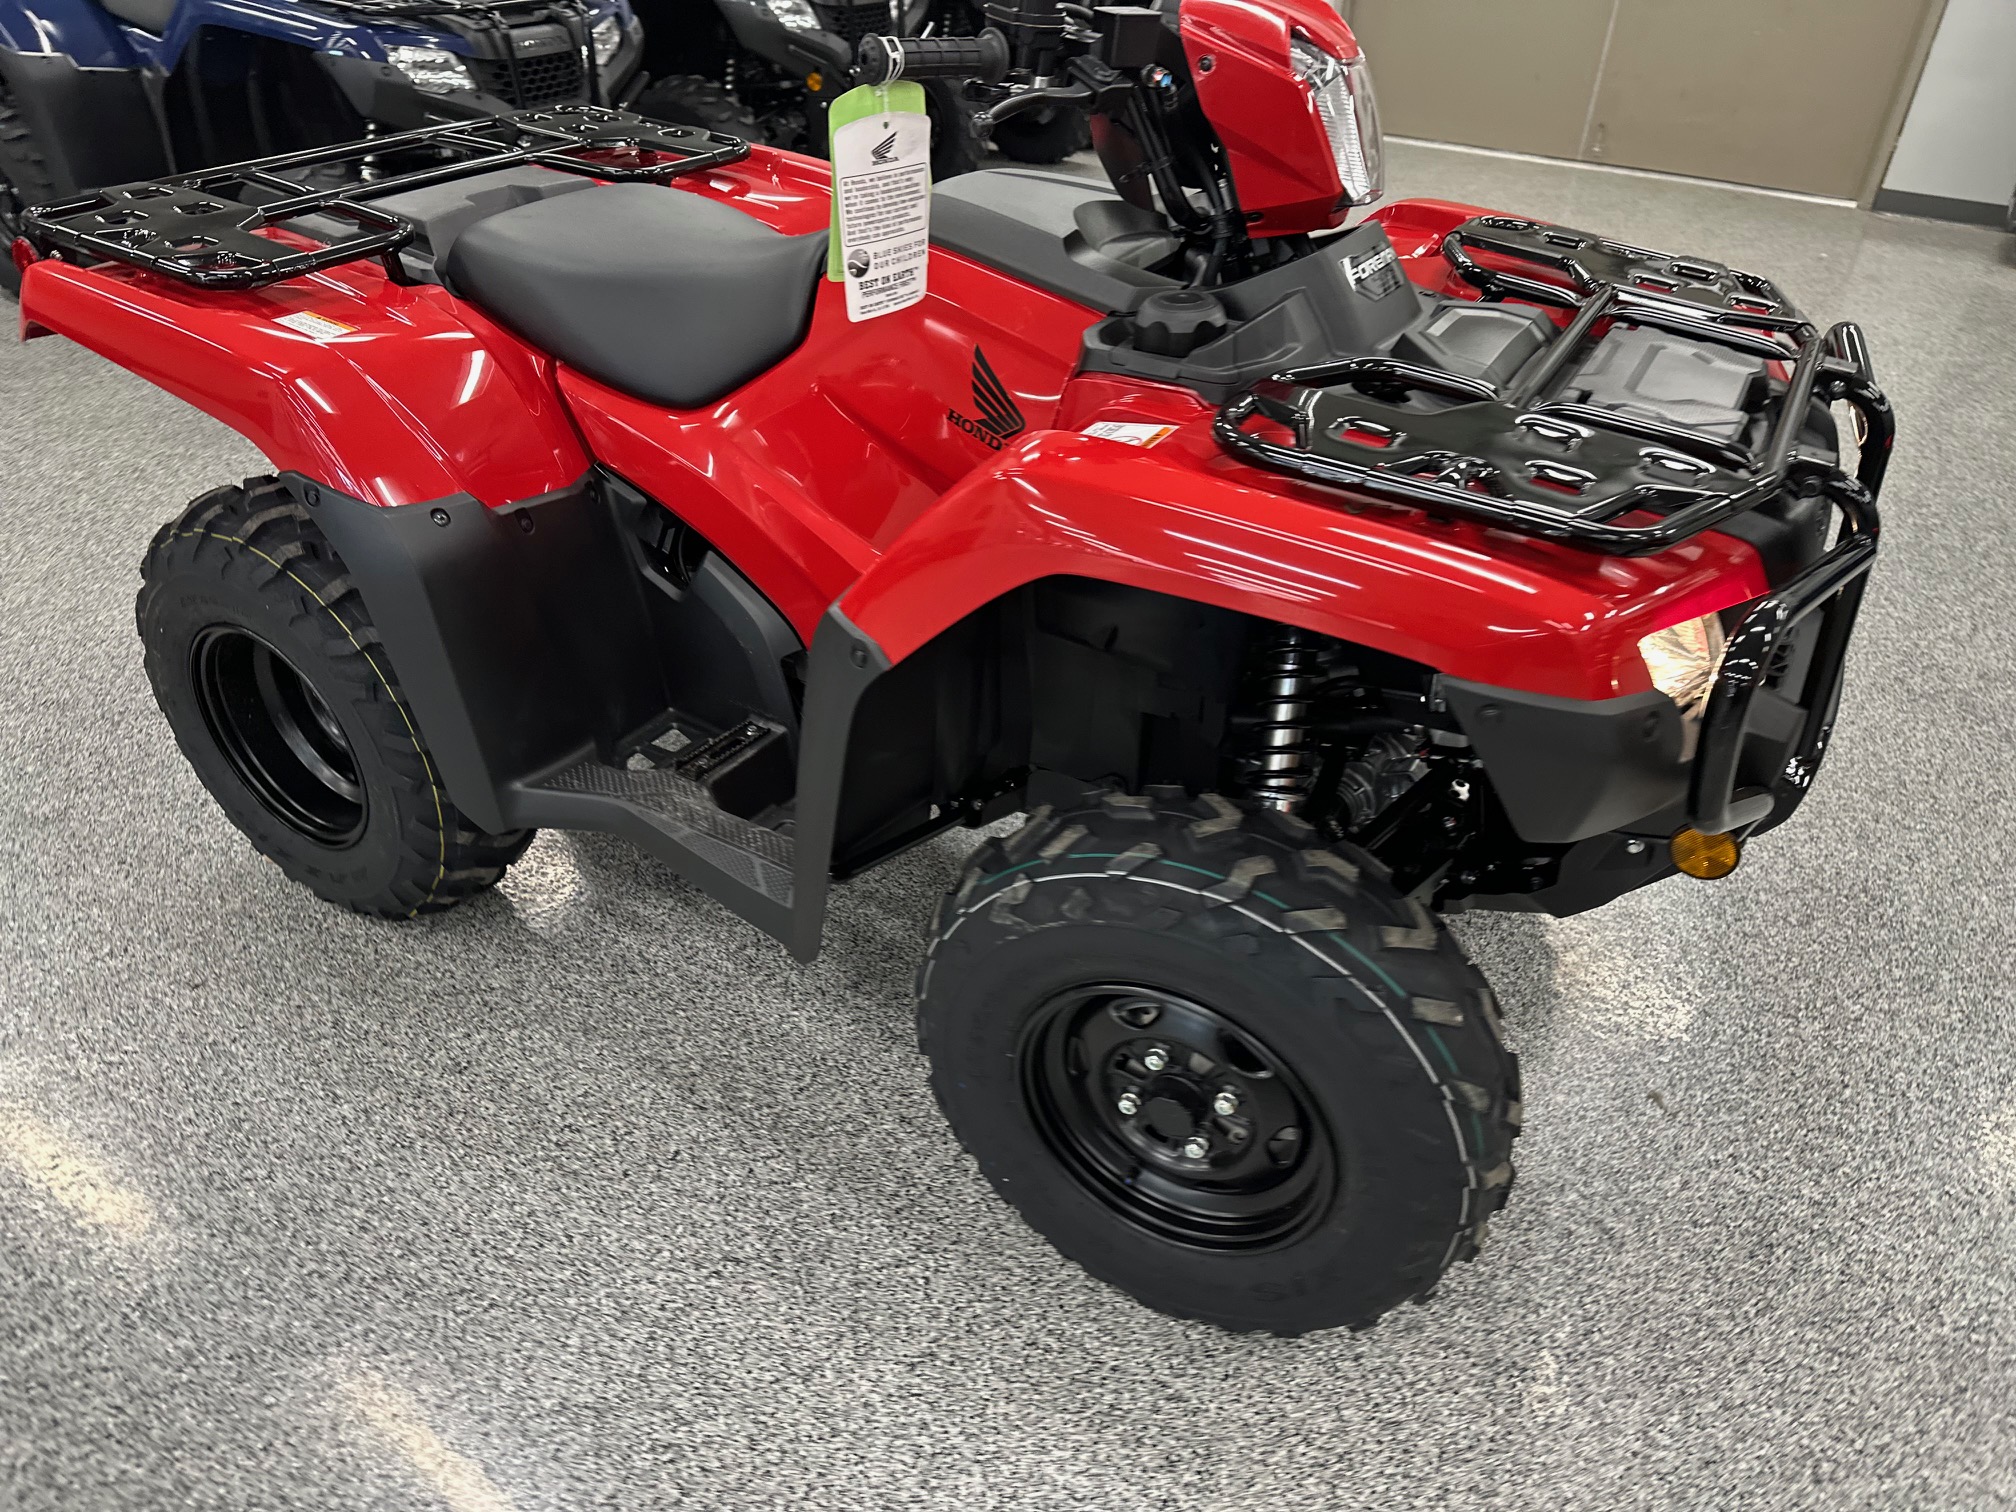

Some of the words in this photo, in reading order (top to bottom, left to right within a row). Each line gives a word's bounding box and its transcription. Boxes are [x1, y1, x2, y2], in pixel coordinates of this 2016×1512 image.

[873, 248, 892, 260] BLUE
[893, 243, 913, 255] SKIES
[913, 238, 926, 248] FOR
[873, 259, 890, 270] OUR
[891, 249, 926, 265] CHILDREN
[858, 278, 879, 291] BEST
[880, 275, 891, 285] ON
[946, 407, 1012, 451] HOND
